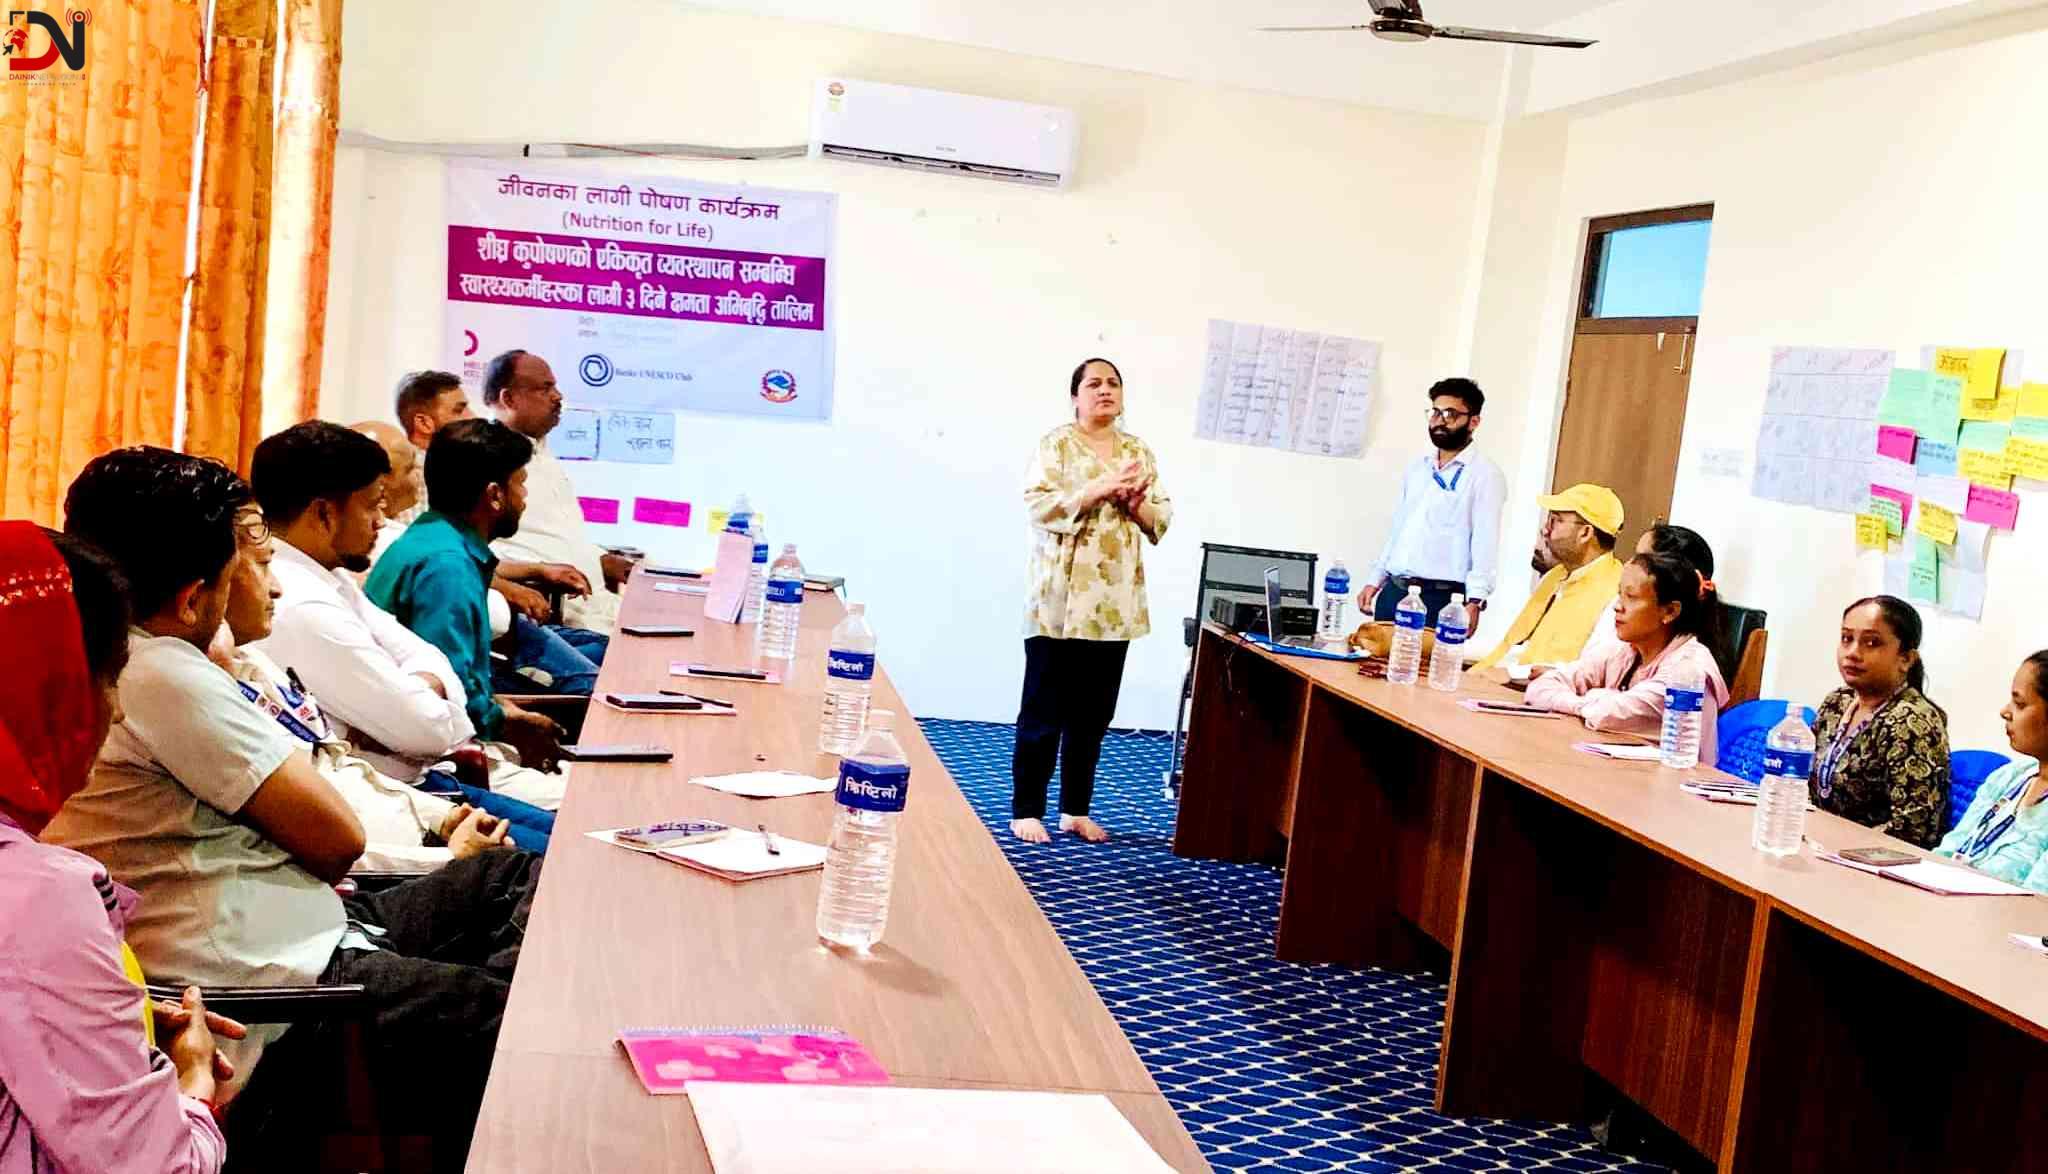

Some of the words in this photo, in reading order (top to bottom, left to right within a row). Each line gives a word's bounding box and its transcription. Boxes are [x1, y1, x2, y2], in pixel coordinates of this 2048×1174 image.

[497, 174, 577, 202] जीवनका
[585, 183, 631, 206] लागी
[639, 186, 691, 213] पोषण
[699, 195, 781, 221] कार्यक्रम
[562, 212, 643, 236] (Nutrition
[649, 219, 671, 235] for
[677, 221, 713, 243] Life)
[625, 289, 636, 310] ३
[771, 298, 815, 323] तालिम
